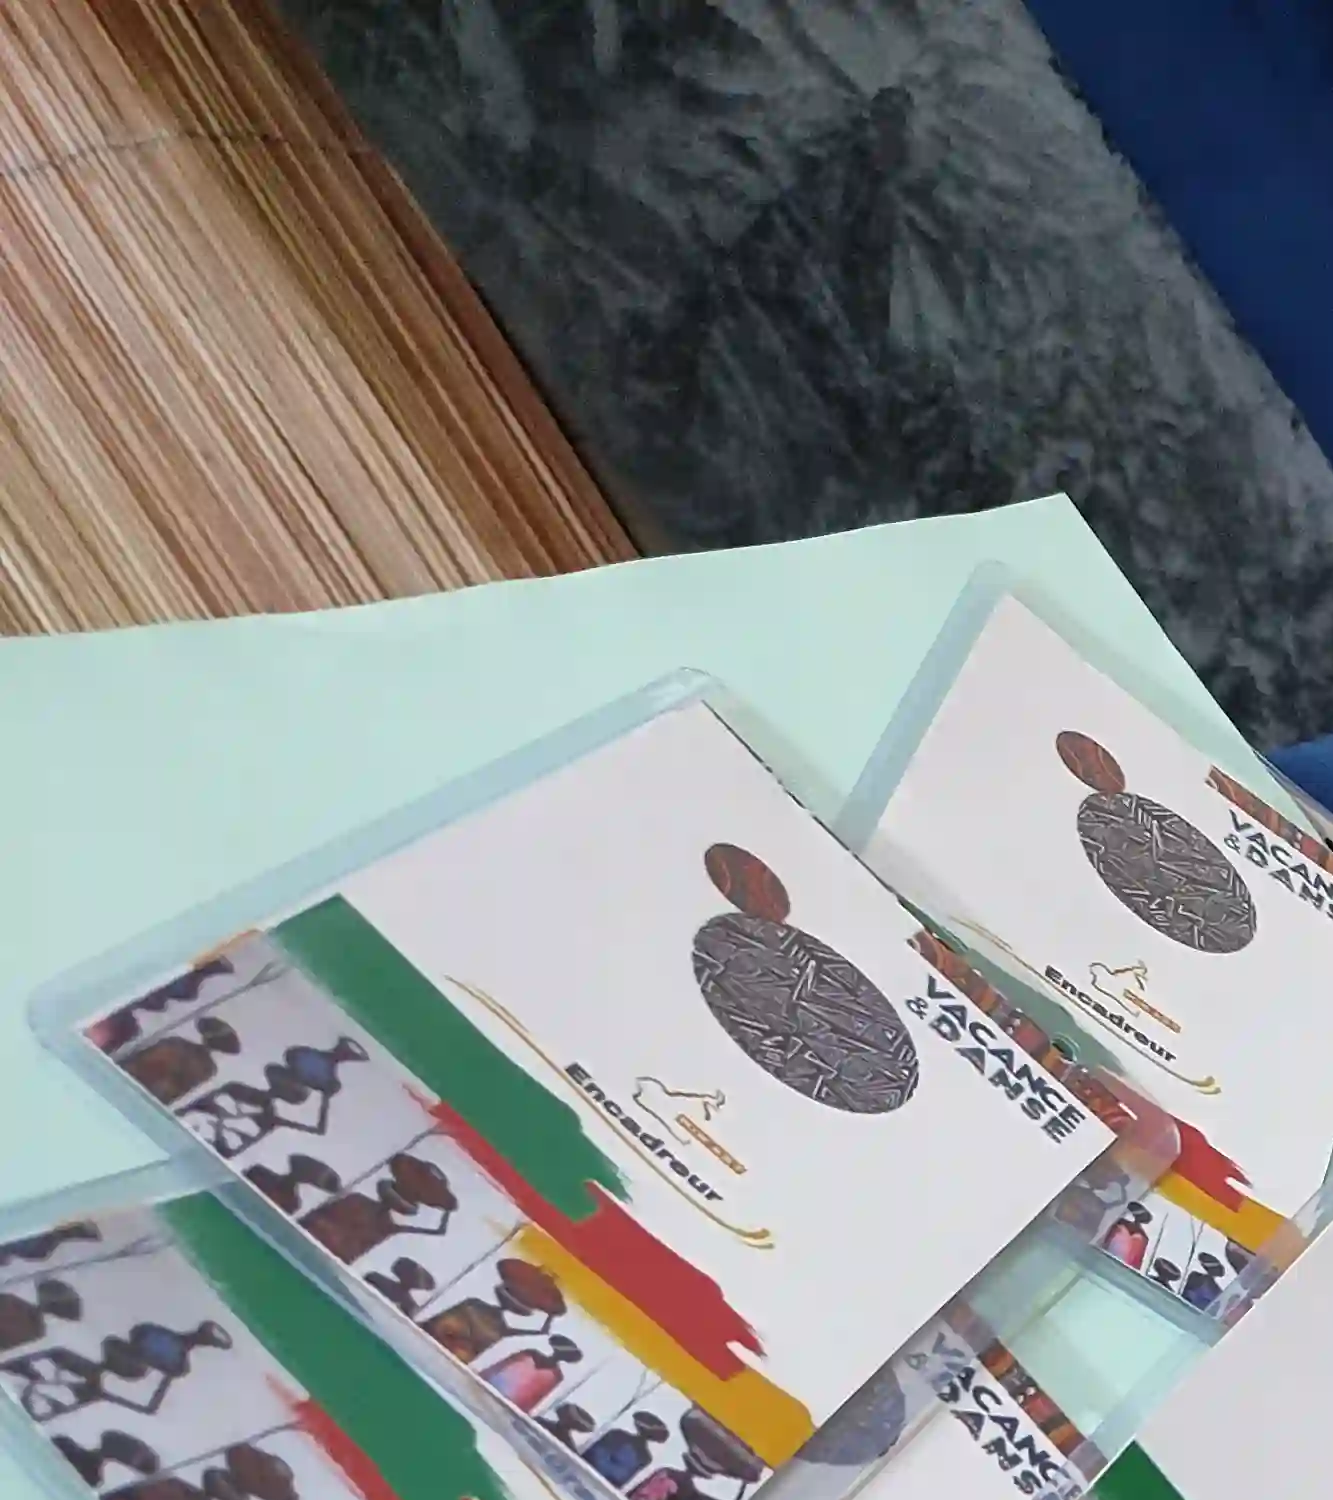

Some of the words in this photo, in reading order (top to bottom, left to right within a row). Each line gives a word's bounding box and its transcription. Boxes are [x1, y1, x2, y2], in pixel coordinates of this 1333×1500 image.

[1223, 833, 1241, 853] &
[906, 996, 928, 1020] &
[929, 1015, 1076, 1143] DANSE
[926, 974, 1086, 1128] VACANCE
[1045, 965, 1177, 1062] Encadreur
[563, 1060, 724, 1202] Encadreur
